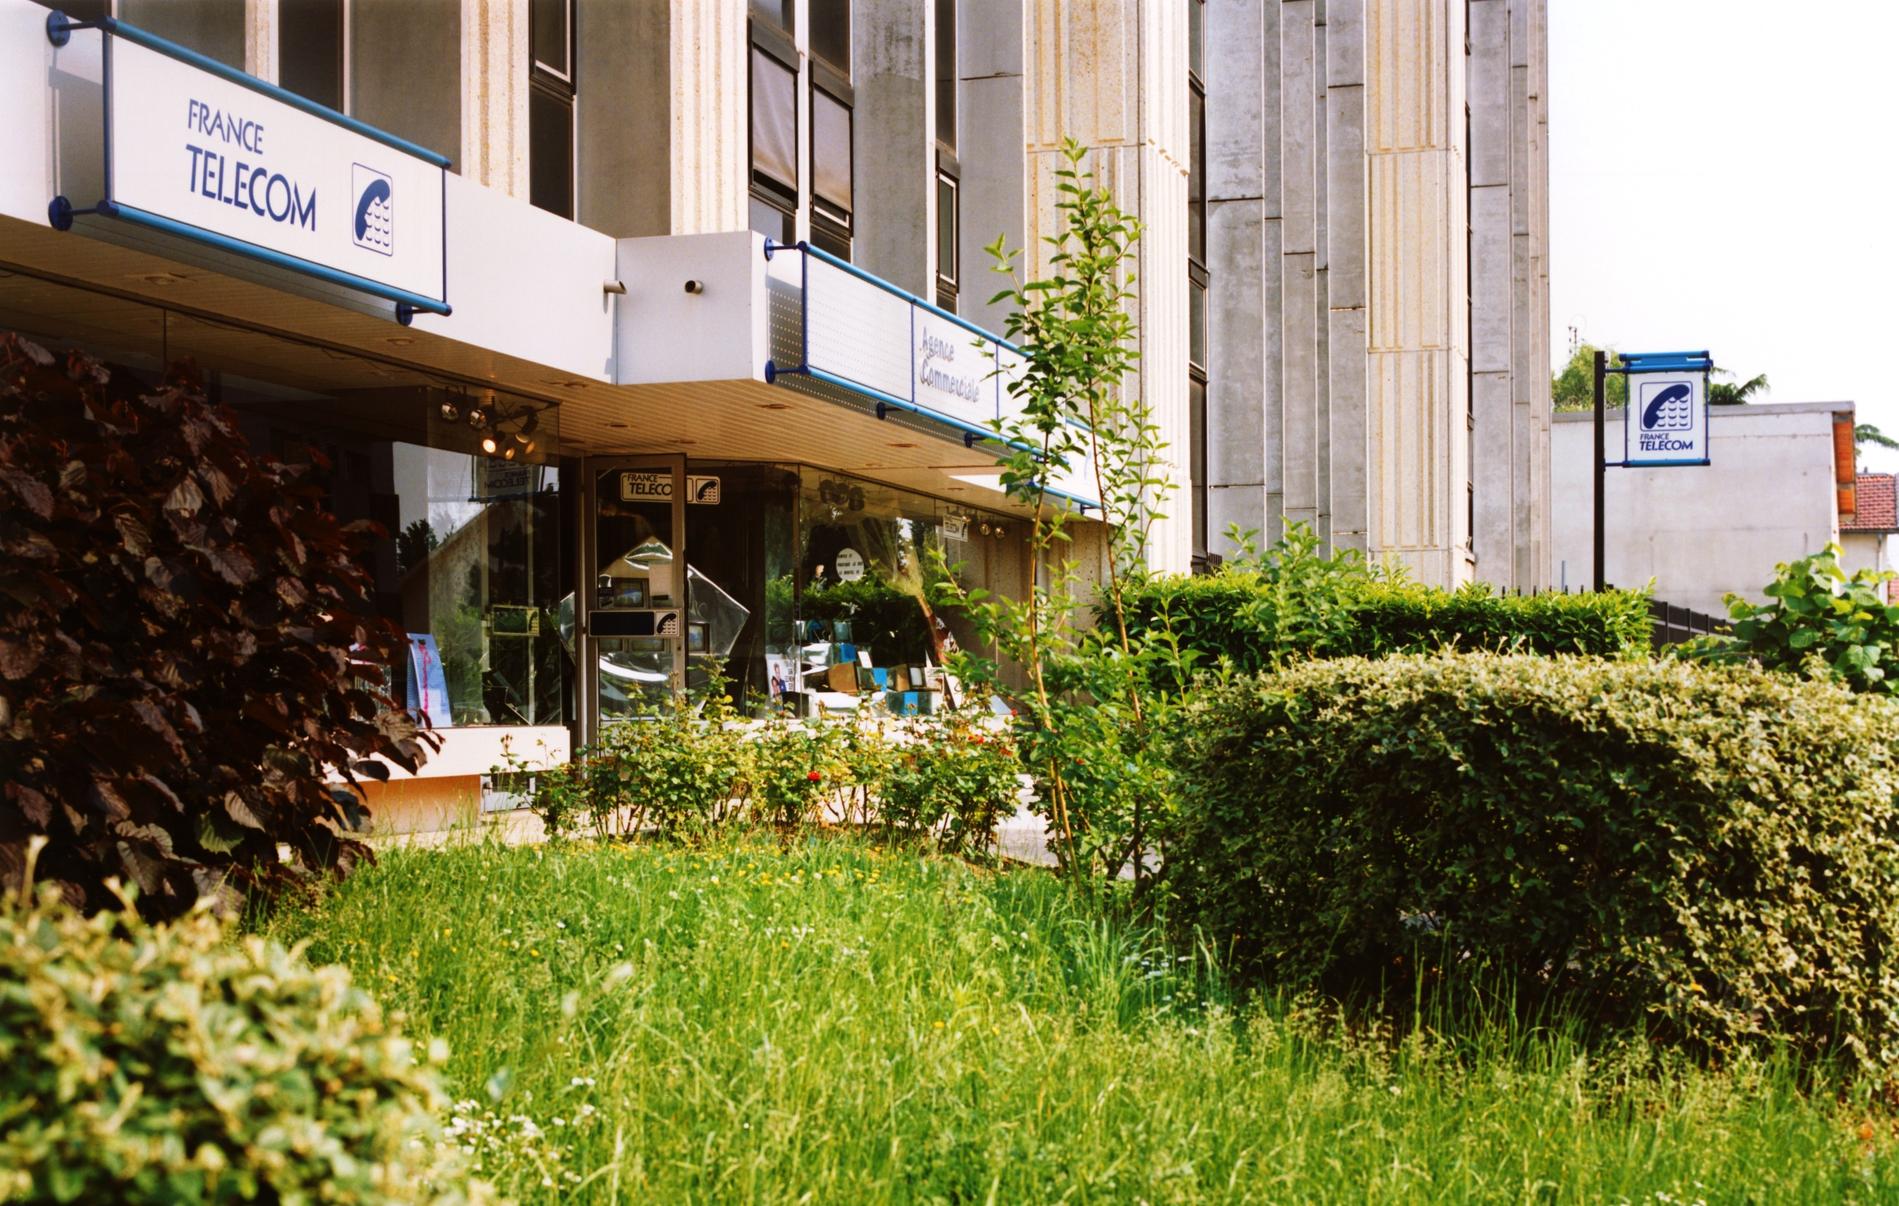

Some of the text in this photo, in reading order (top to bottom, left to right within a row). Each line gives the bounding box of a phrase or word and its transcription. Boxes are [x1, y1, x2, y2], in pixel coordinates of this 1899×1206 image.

[188, 99, 264, 154] FRANCE
[186, 144, 316, 231] TELECOM
[921, 327, 954, 361] Agence
[920, 358, 980, 402] Commerciale
[1640, 432, 1669, 440] FRANCE
[1640, 440, 1693, 451] TELECOM
[627, 473, 658, 483] FRANCE
[629, 482, 672, 496] TELECO
